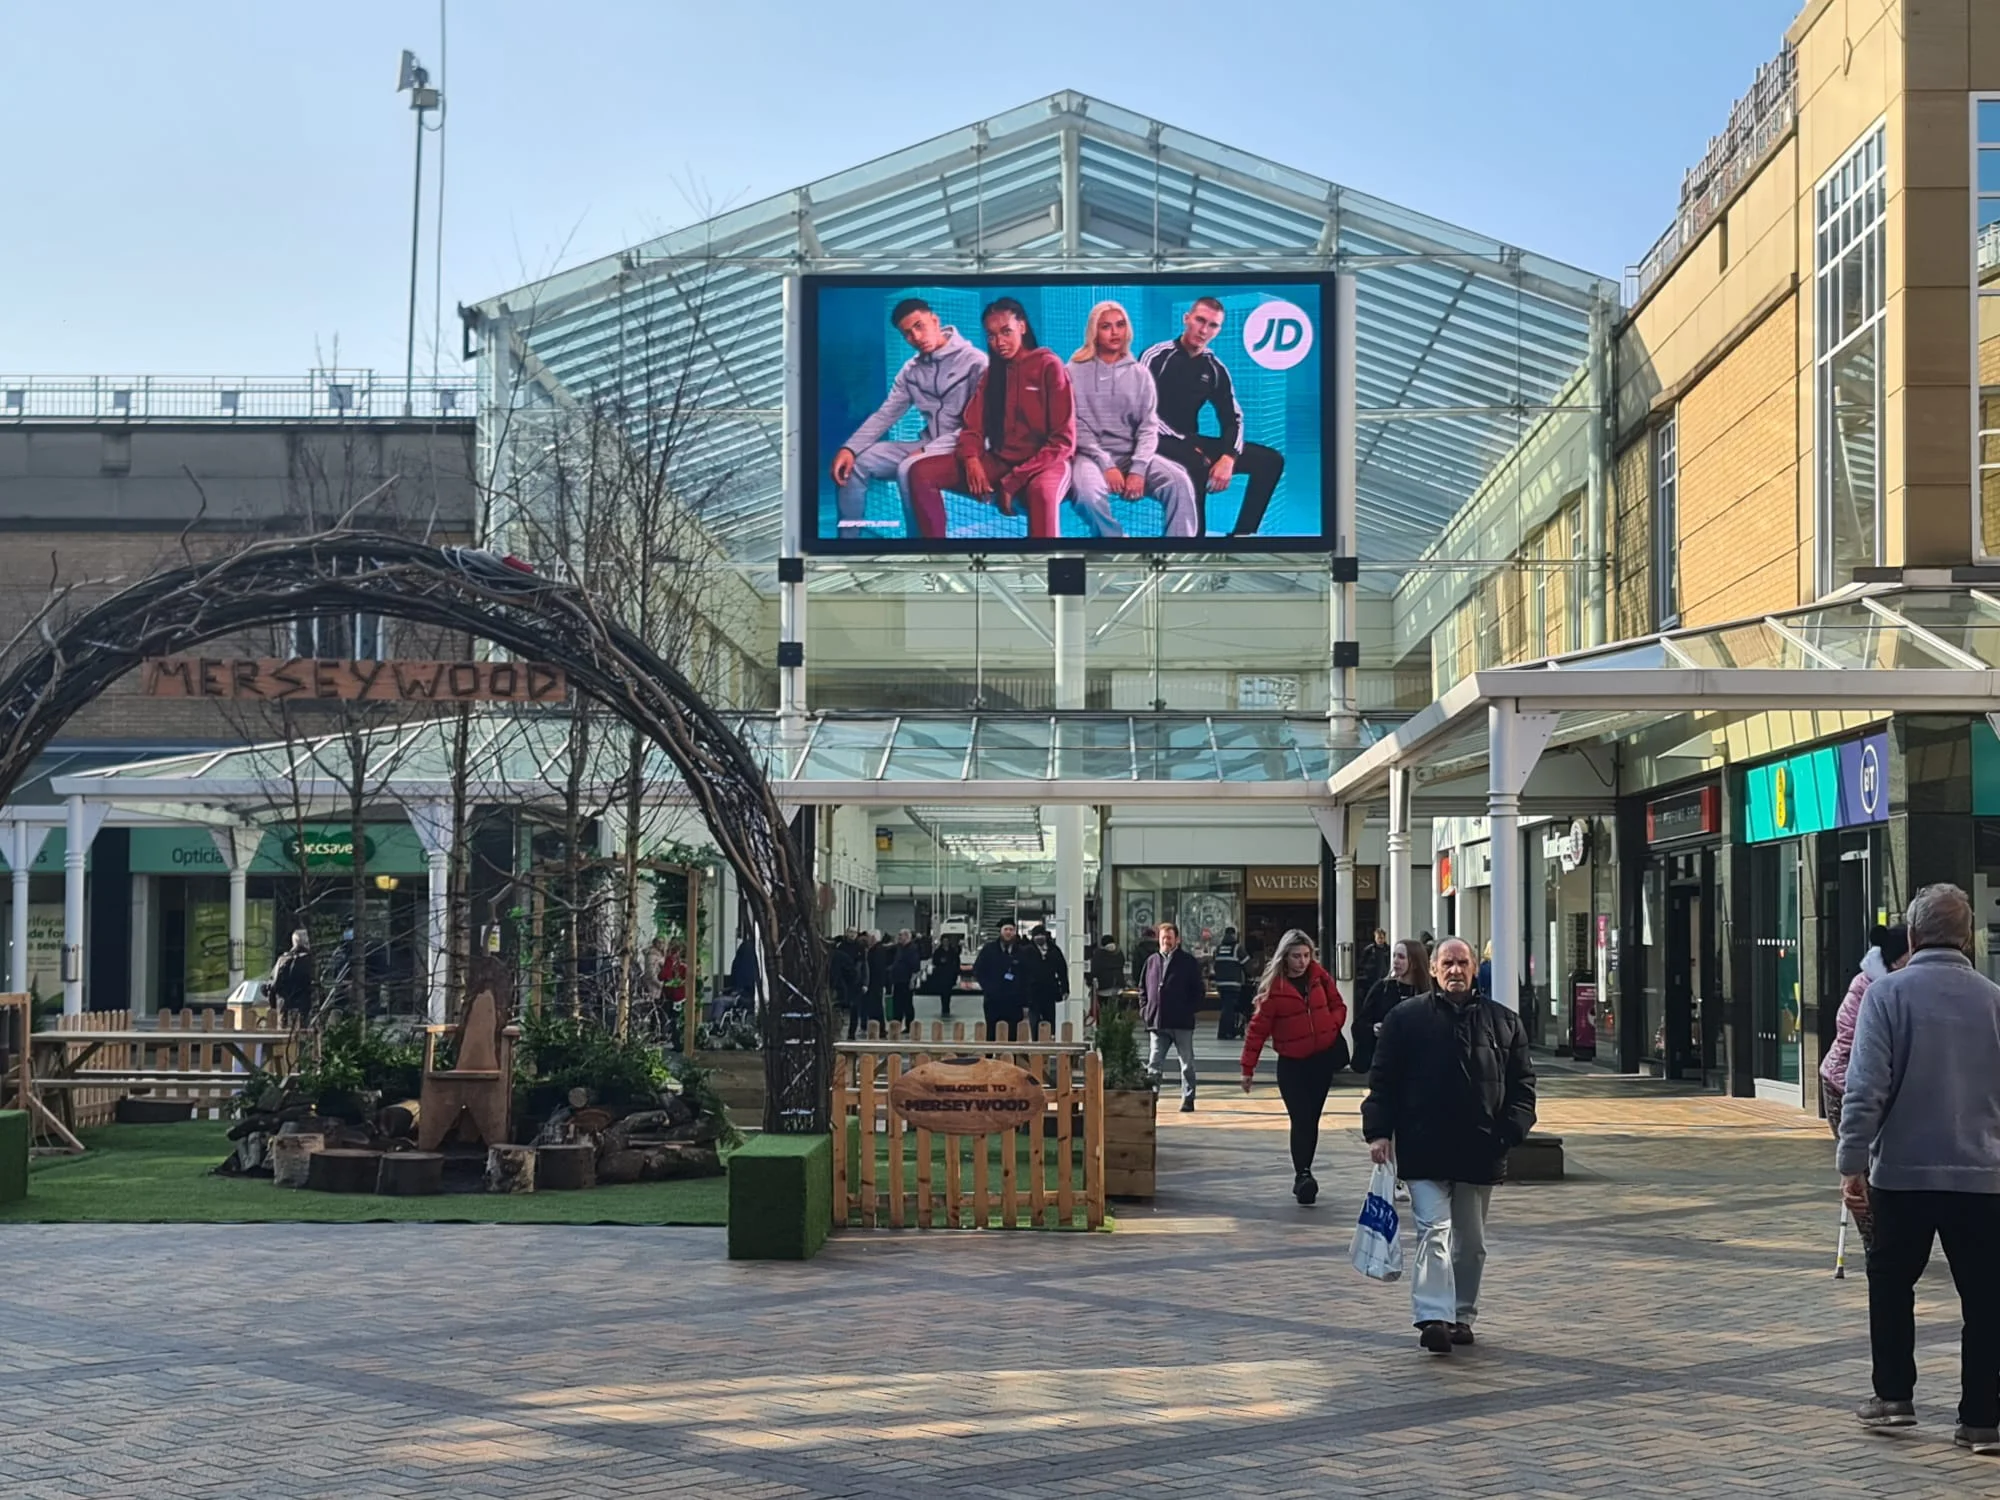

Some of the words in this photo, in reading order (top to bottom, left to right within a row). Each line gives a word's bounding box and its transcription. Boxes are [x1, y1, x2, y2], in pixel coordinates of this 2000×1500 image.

[1252, 317, 1304, 353] JD
[148, 657, 560, 699] MERSEYWOOD
[1864, 765, 1875, 793] BT
[172, 847, 225, 867] Opticia
[934, 1084, 989, 1094] WELCOME
[992, 1084, 1008, 1094] TO
[904, 1098, 1030, 1112] MERSEYWOOD
